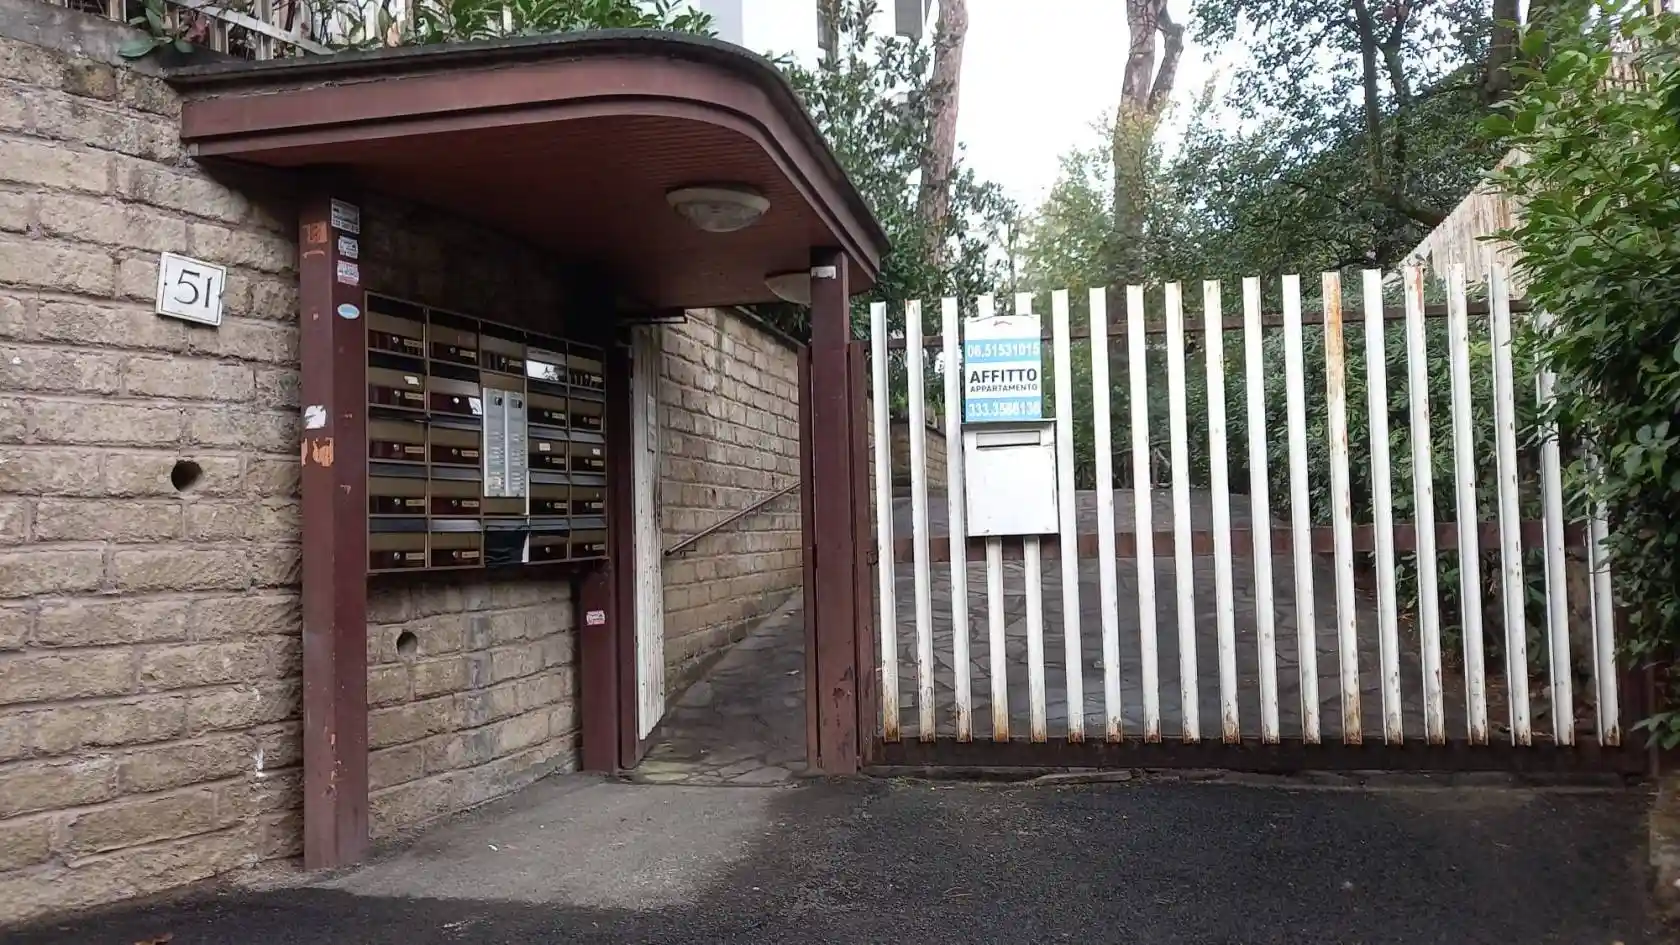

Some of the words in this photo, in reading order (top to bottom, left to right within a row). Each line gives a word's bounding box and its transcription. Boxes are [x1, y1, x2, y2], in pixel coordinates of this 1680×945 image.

[174, 268, 213, 308] 51
[969, 368, 1038, 384] AFFITTO
[970, 383, 1038, 393] APPARTAMENTO
